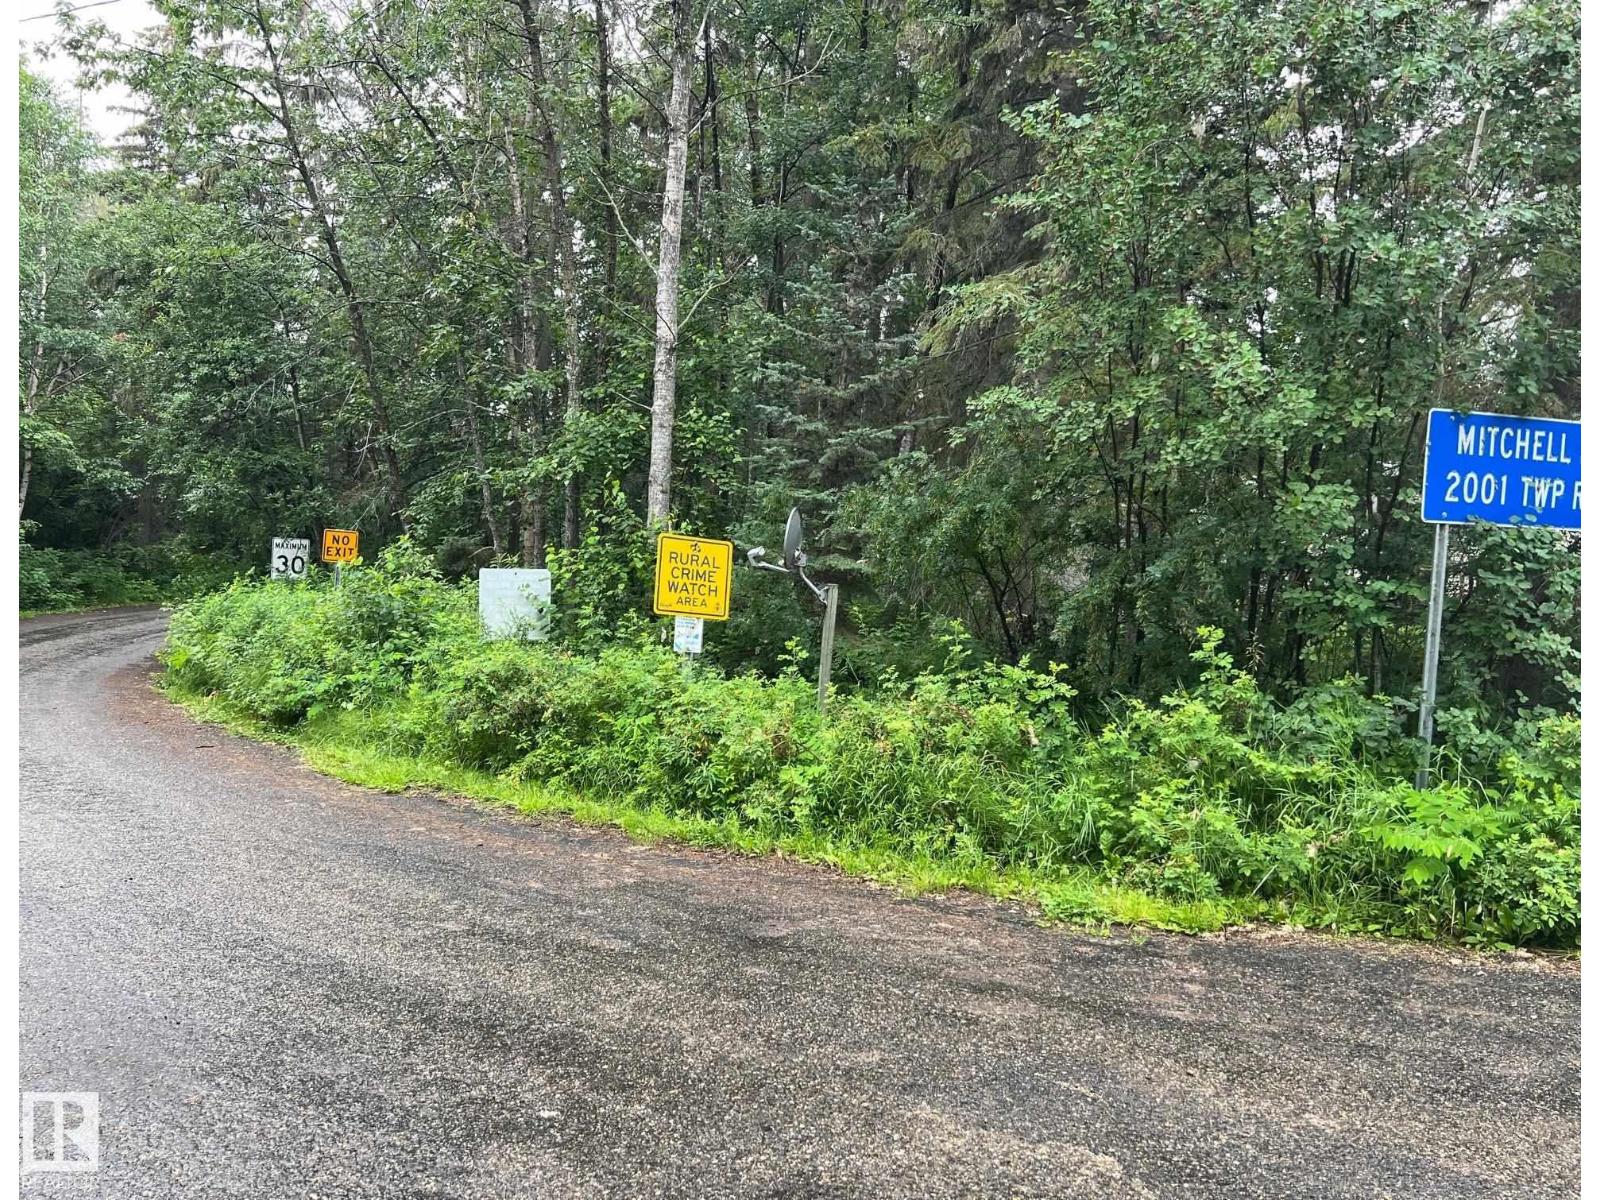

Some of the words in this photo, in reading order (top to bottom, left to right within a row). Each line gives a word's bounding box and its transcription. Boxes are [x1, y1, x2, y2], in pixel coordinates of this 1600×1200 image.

[1457, 424, 1571, 464] MITCHELL
[1444, 470, 1508, 505] 2001
[1521, 475, 1565, 509] TWP
[275, 542, 307, 550] MAXIMUM
[332, 535, 349, 545] NO
[326, 546, 354, 557] EXIT
[276, 555, 305, 574] 30
[669, 551, 720, 569] RURAL
[671, 566, 717, 583] CRIME
[668, 581, 718, 597] WATCH
[676, 596, 708, 608] AREA
